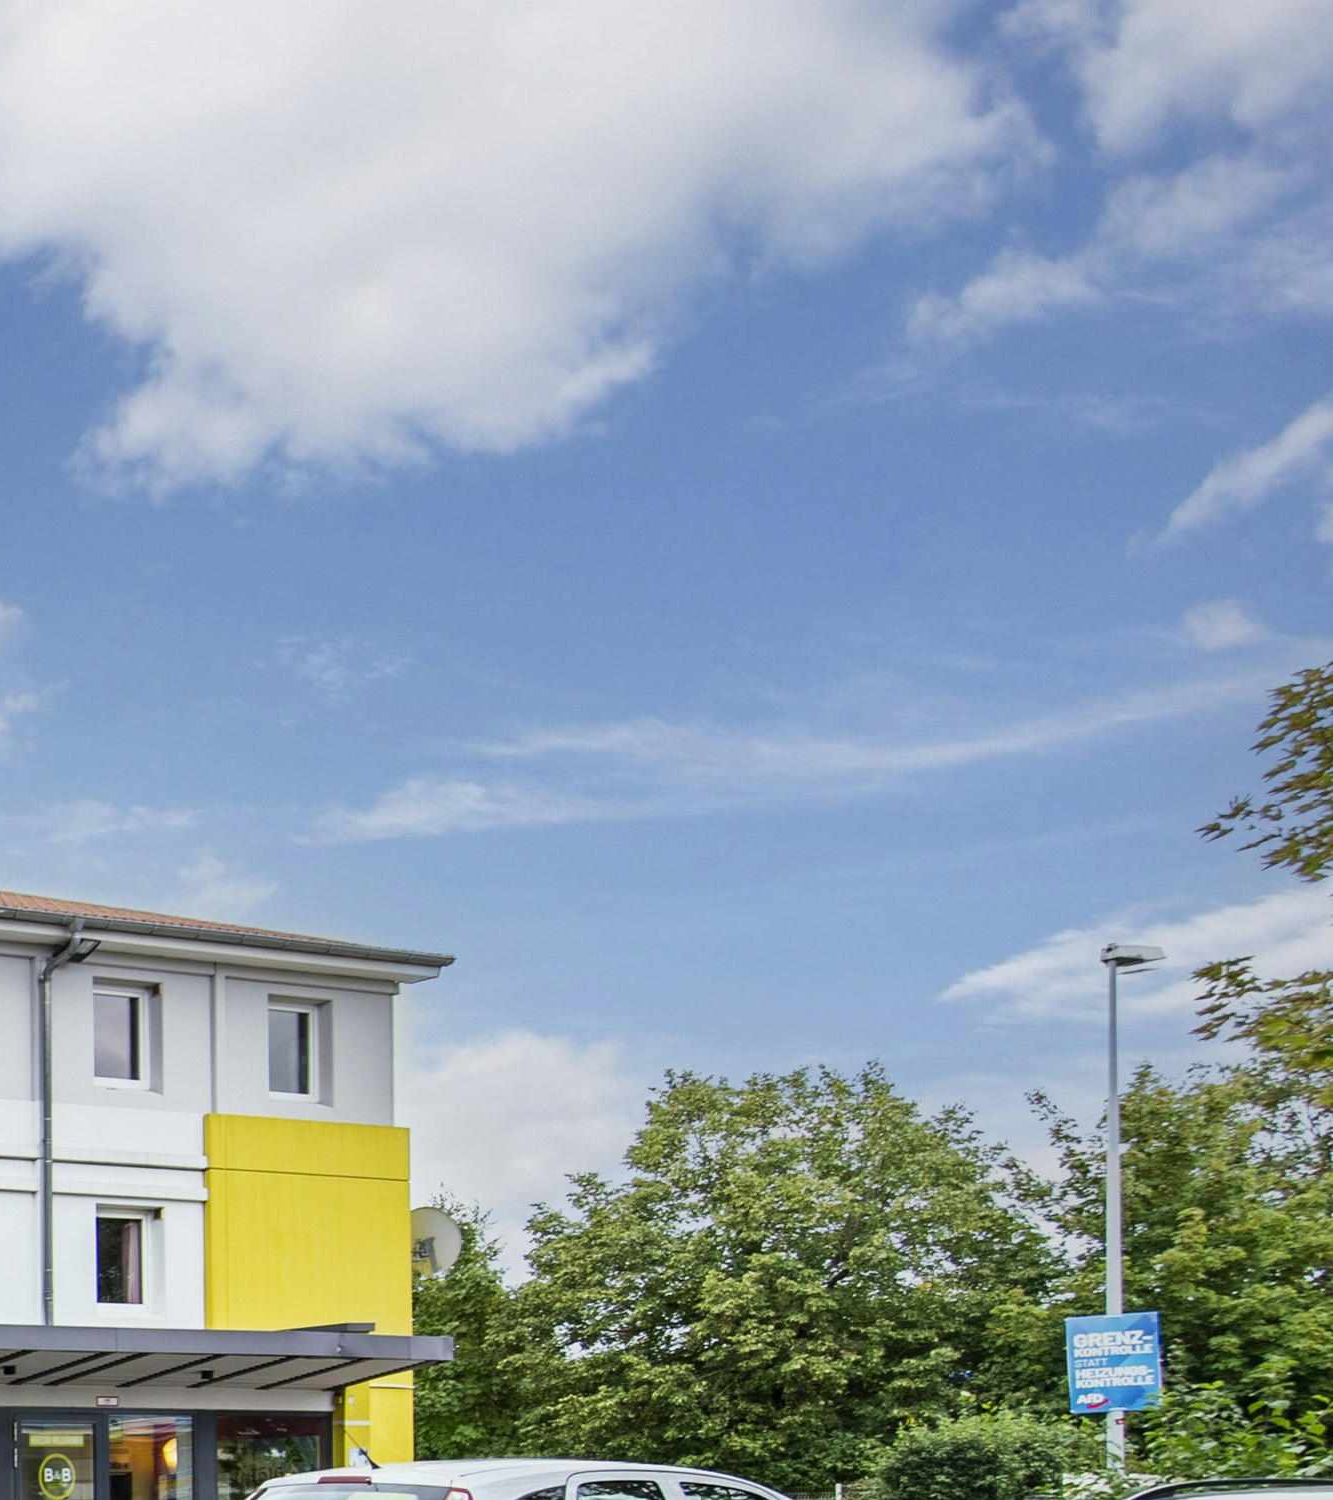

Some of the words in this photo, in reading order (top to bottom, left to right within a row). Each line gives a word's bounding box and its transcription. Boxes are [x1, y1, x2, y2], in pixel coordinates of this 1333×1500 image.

[1073, 1330, 1153, 1348] GRENZ-
[1074, 1344, 1153, 1358] KONTROLLE
[1075, 1358, 1108, 1368] STATT
[1075, 1365, 1154, 1379] HEIZUNGS-
[1076, 1375, 1155, 1389] KONTROLLE
[44, 1468, 72, 1482] B&B
